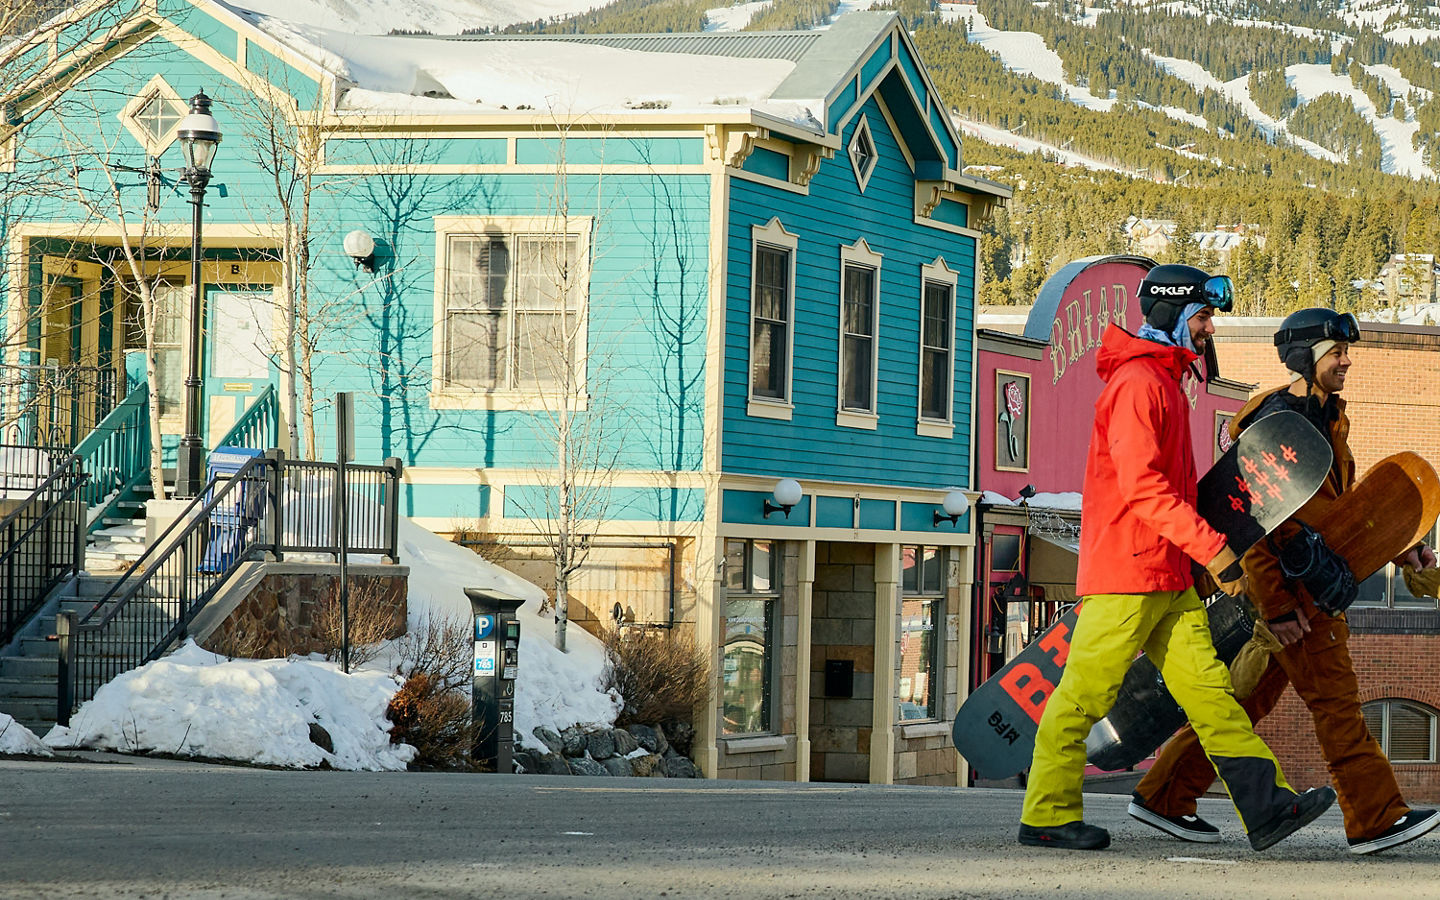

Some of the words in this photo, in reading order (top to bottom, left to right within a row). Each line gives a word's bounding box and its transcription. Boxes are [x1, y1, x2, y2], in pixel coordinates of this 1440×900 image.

[231, 264, 241, 275] B
[1150, 285, 1195, 296] OAKLEY
[1050, 284, 1128, 387] BRIAR
[478, 617, 490, 635] P
[500, 711, 513, 723] 785
[987, 710, 1021, 746] MFG
